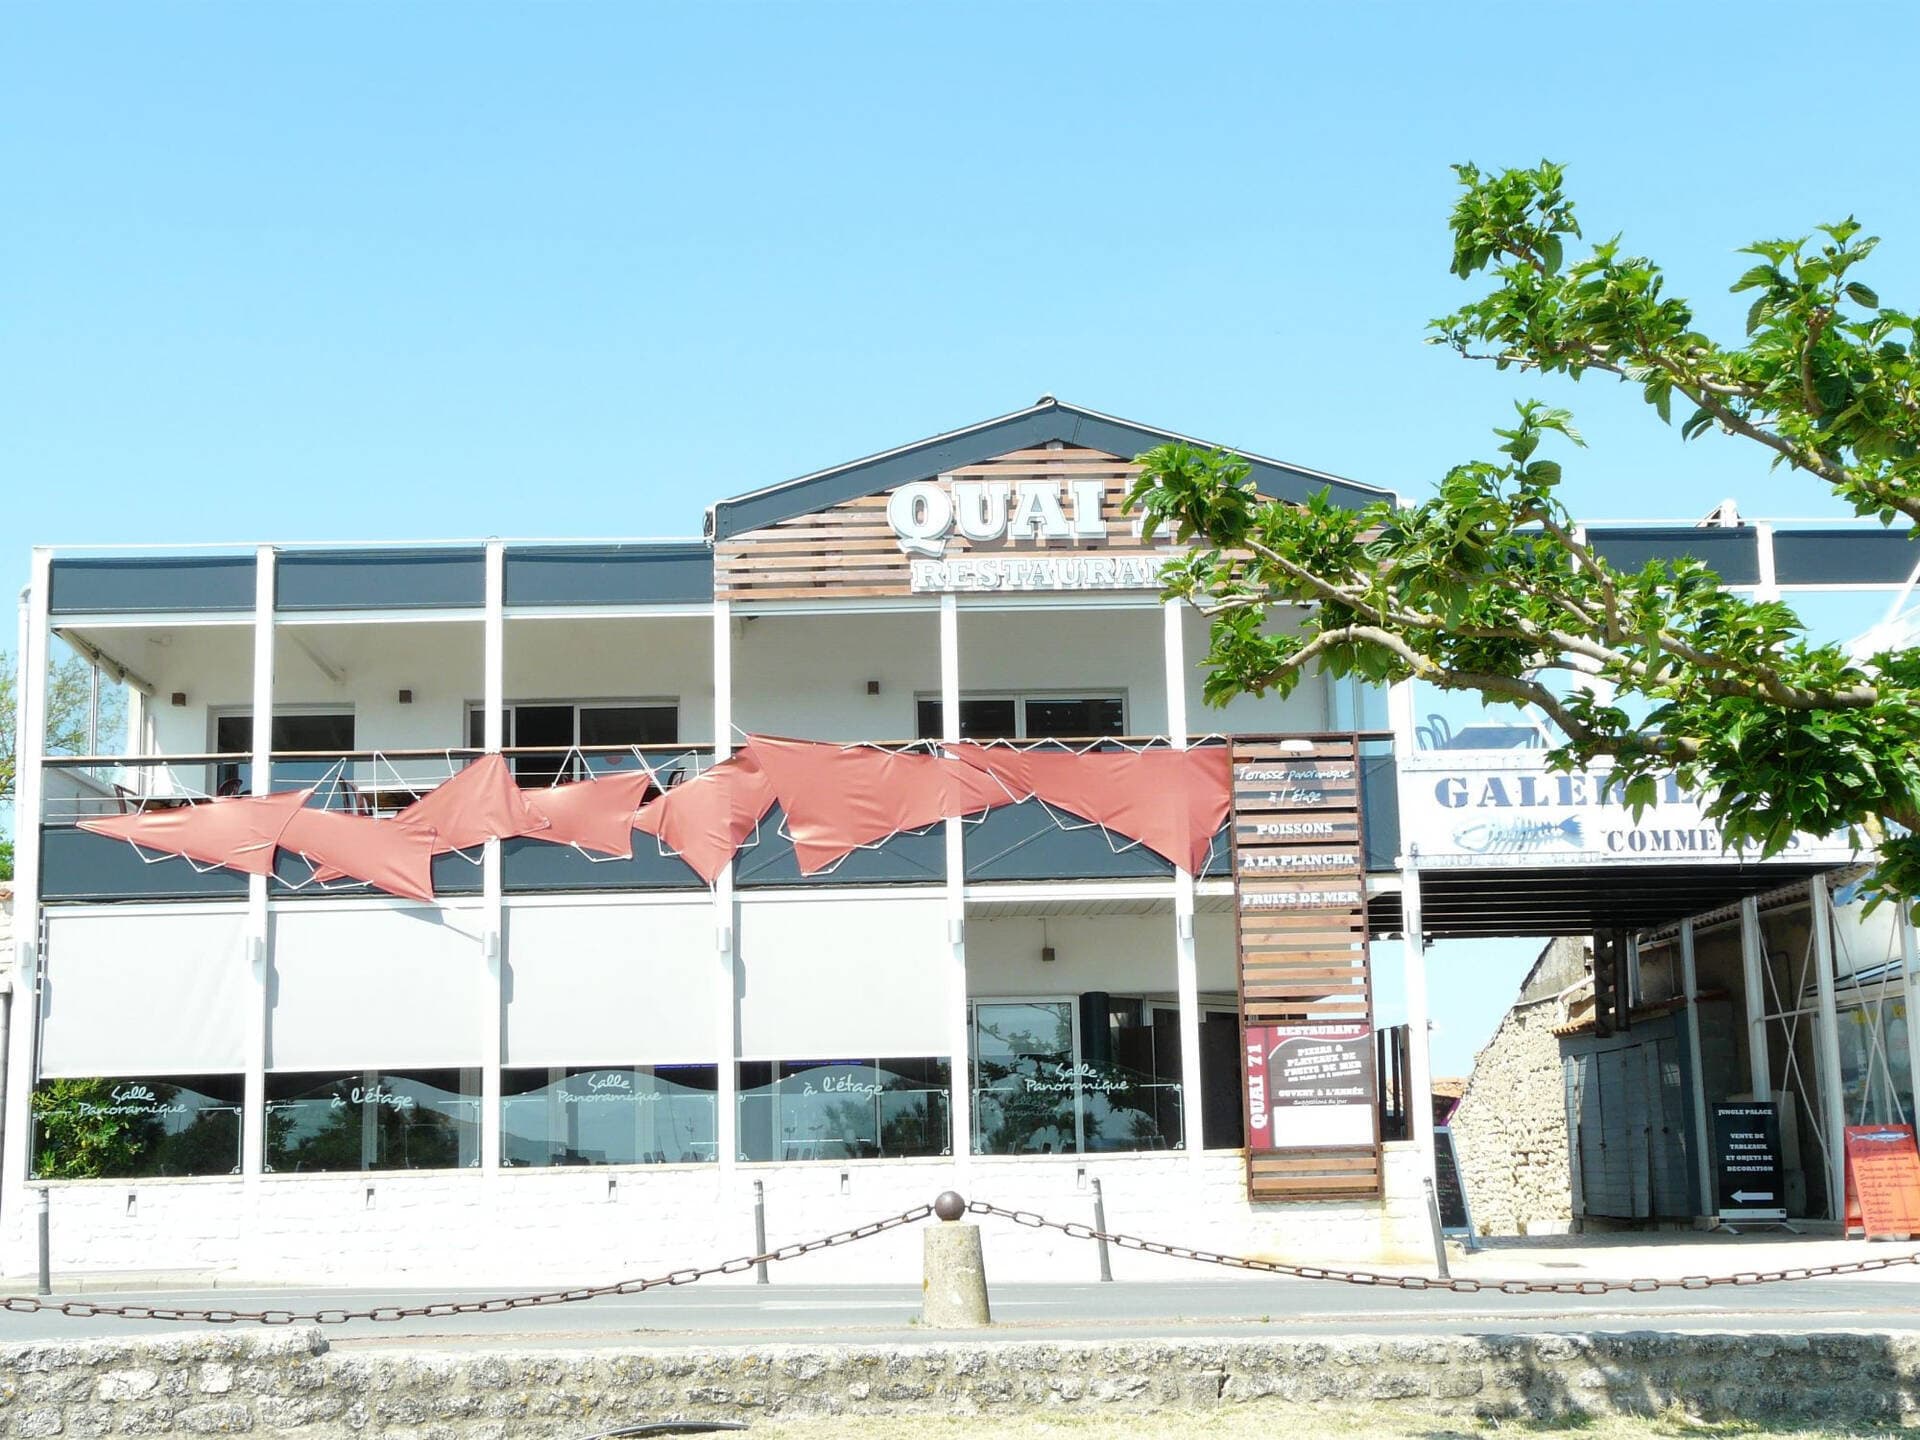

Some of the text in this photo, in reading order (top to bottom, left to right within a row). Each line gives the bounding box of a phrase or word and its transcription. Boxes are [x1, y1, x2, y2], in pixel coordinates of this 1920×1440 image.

[887, 480, 1107, 557] QUAI
[912, 556, 1190, 592] RESTAURAN
[1239, 766, 1350, 782] Terrasse panoramique
[1434, 773, 1698, 809] GALERE
[1256, 822, 1333, 836] POISSONS
[1243, 853, 1355, 868] À LA PLANCHA
[1243, 891, 1359, 906] FRUITS DE MER
[1277, 1025, 1361, 1037] RESTAURANT
[1342, 1052, 1357, 1060] DE
[1055, 1062, 1098, 1082] Salle
[1284, 1060, 1362, 1077] FRUITS DE MER
[588, 1072, 631, 1090] Salle
[803, 1074, 885, 1099] à l'étage
[1024, 1078, 1129, 1096] Panoramique
[111, 1084, 156, 1103] Salle
[331, 1085, 414, 1113] à l'étage
[556, 1088, 662, 1104] Panoramique
[1278, 1088, 1314, 1097] OUVERT
[78, 1101, 188, 1117] Panoramique
[1249, 1075, 1268, 1129] QUAI
